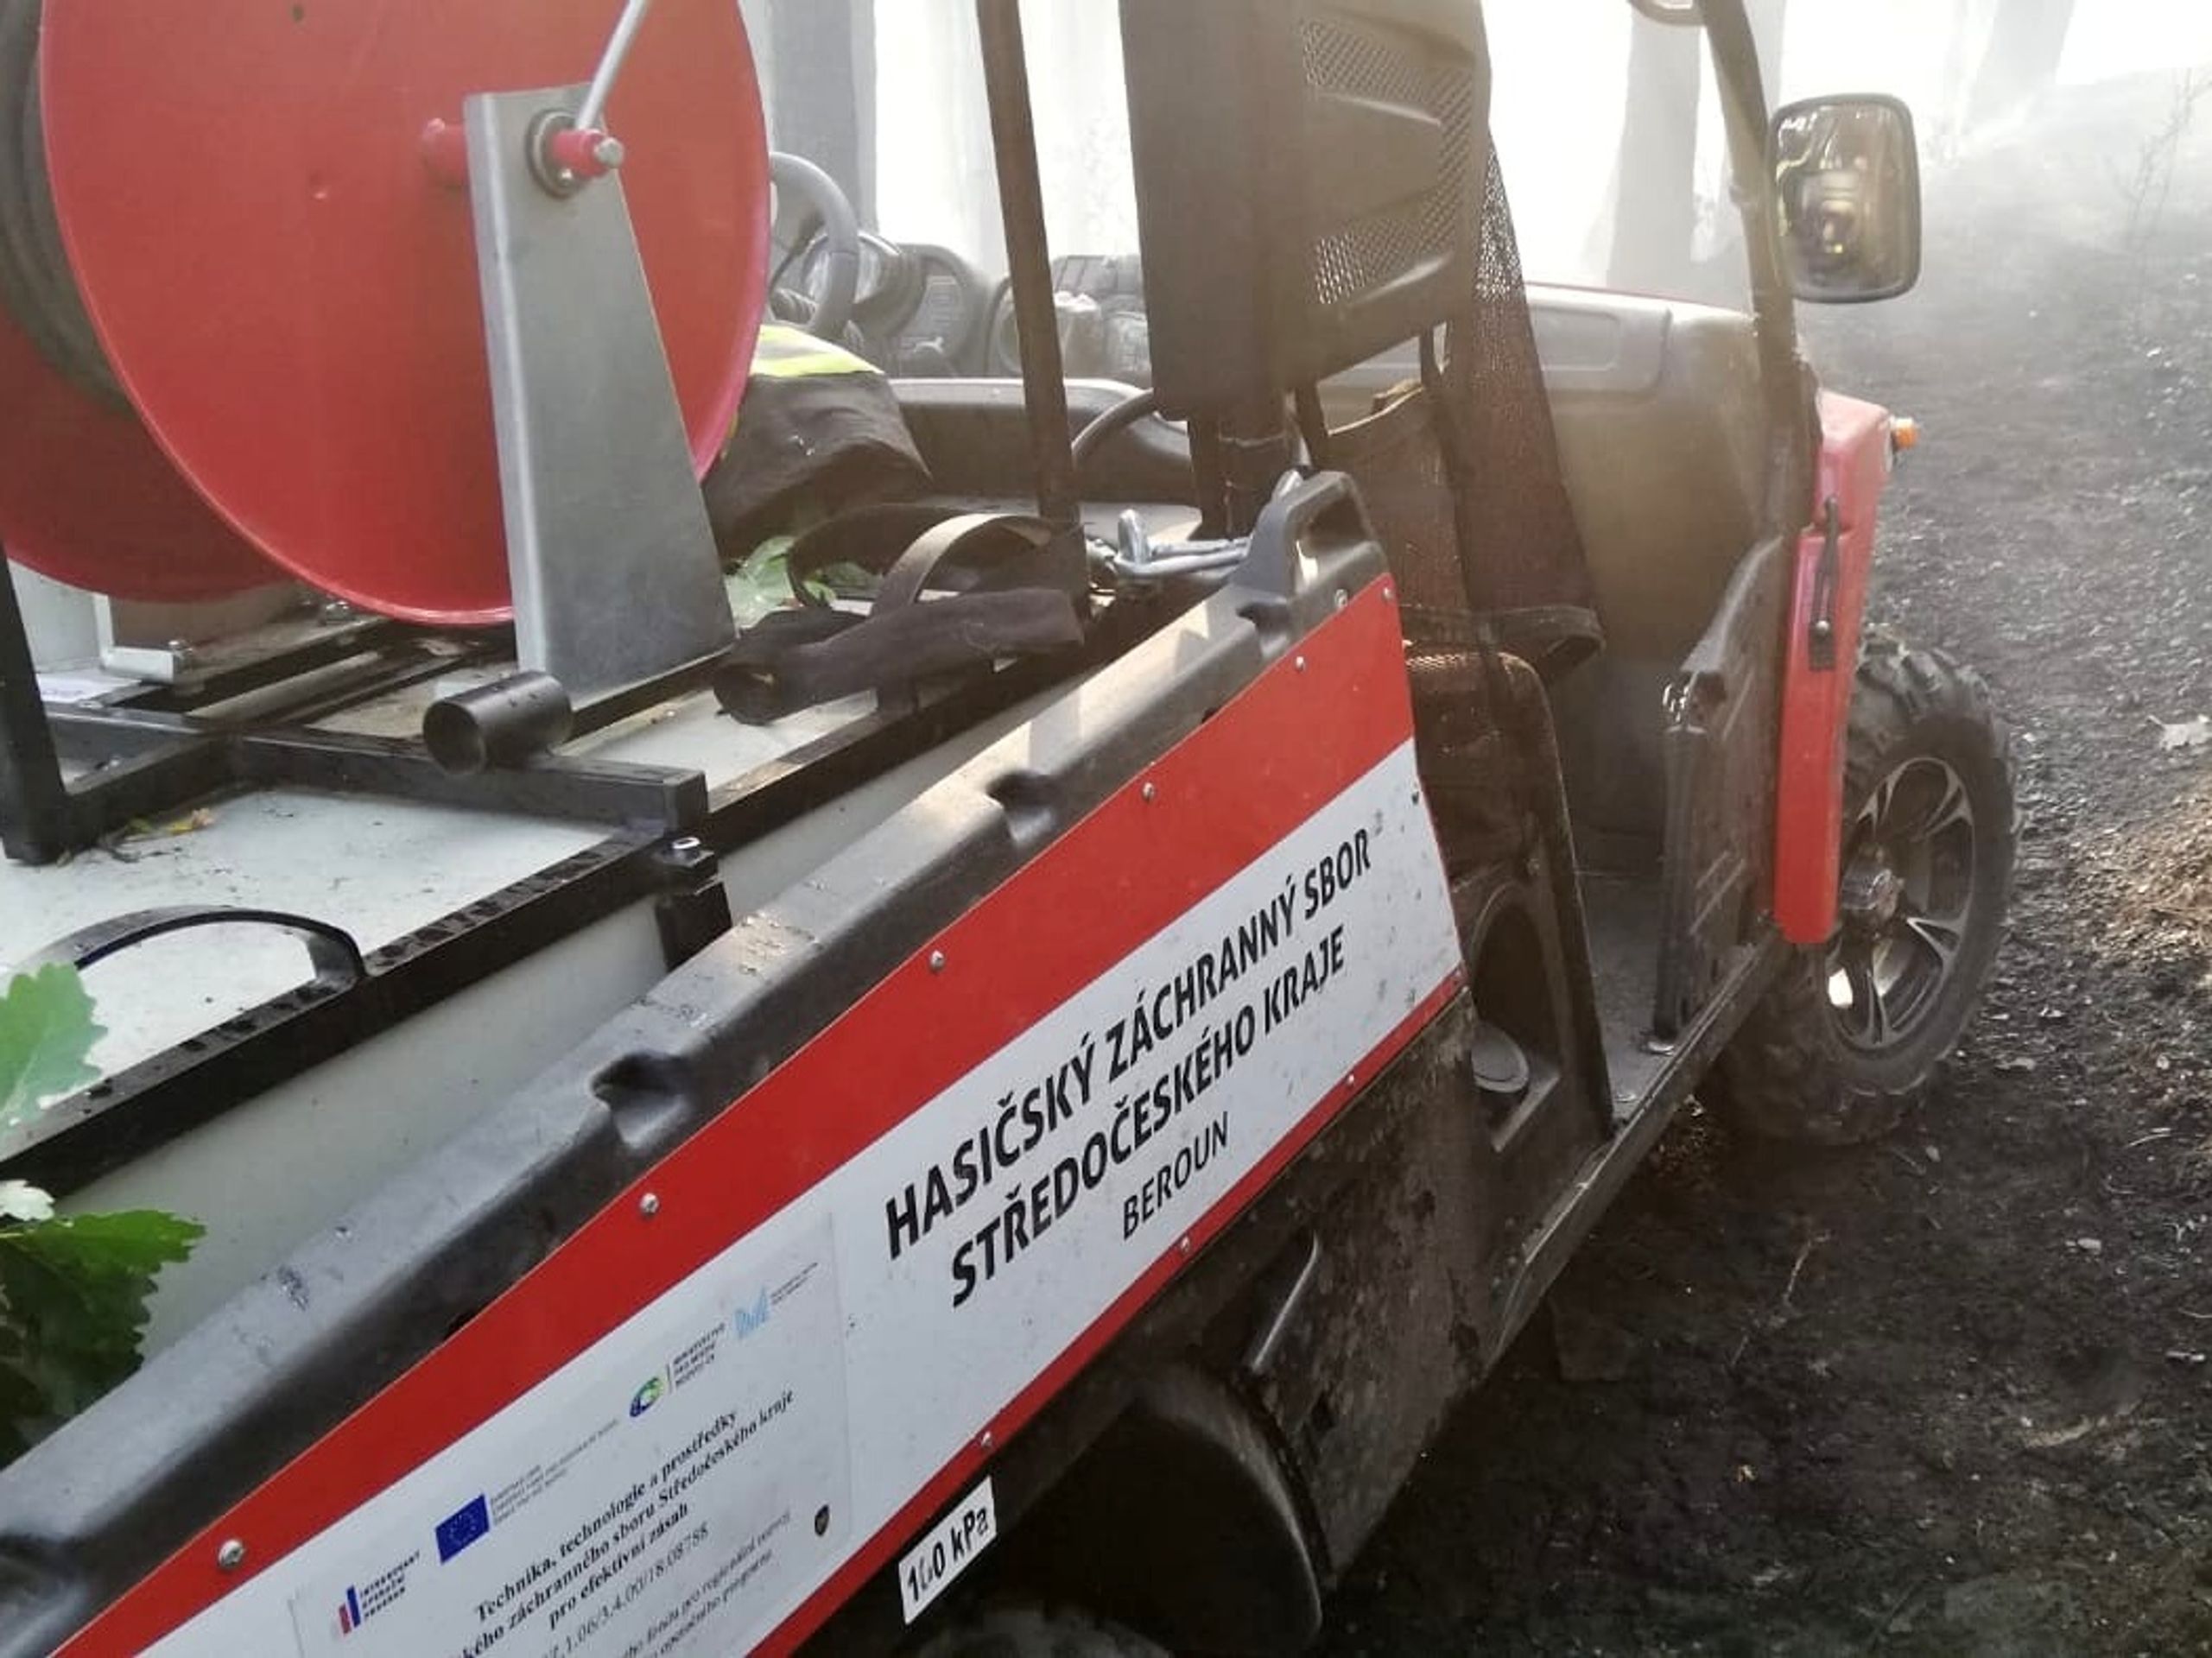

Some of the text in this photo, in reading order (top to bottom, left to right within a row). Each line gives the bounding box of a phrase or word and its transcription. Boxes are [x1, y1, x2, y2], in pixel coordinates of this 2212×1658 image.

[885, 827, 1372, 1260] HASIČSKÝ ZÁCHRANNÝ SBOR
[953, 924, 1345, 1307] STŘEDOČESKÉHO KRAJE
[1123, 1111, 1228, 1240] BEROUN
[509, 1541, 610, 1630] záchranného
[612, 1503, 655, 1544] sboru
[658, 1421, 757, 1508] Středočeského
[759, 1389, 794, 1425] kraje
[560, 1482, 645, 1558] technologie
[662, 1411, 737, 1479] prostředky
[952, 1507, 988, 1562] kPa
[548, 1596, 576, 1631] pro
